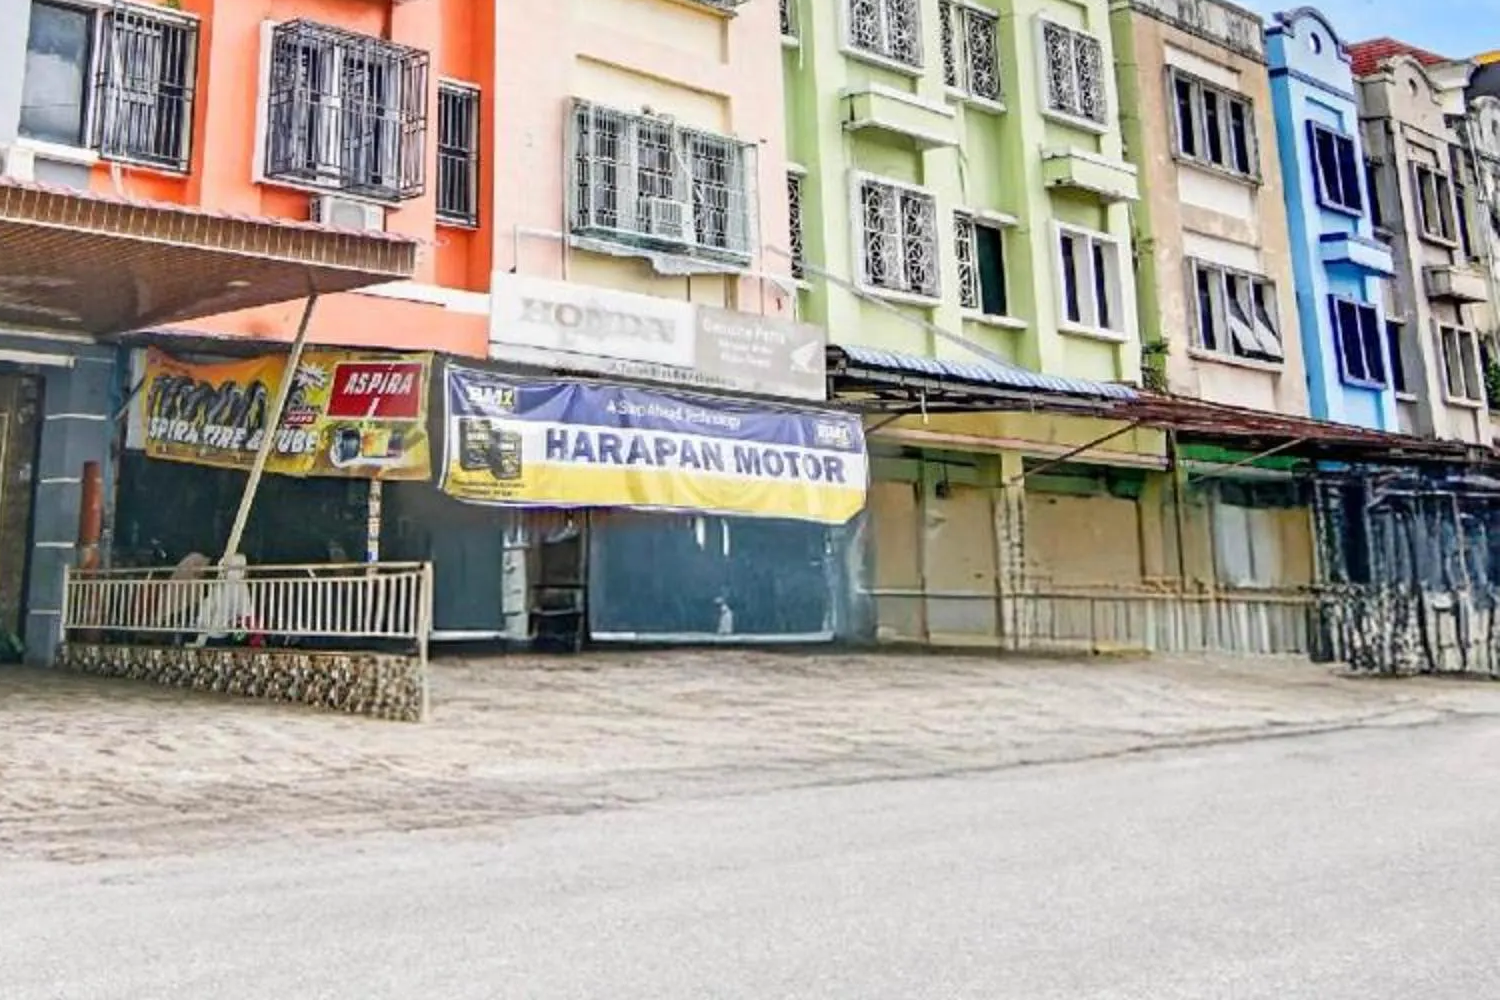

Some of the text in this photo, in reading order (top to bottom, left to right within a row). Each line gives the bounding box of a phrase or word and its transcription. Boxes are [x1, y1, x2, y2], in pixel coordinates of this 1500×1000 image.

[148, 416, 198, 444] SPIRA
[203, 424, 247, 448] TIRE
[545, 427, 846, 483] HARAPAN MOTOR
